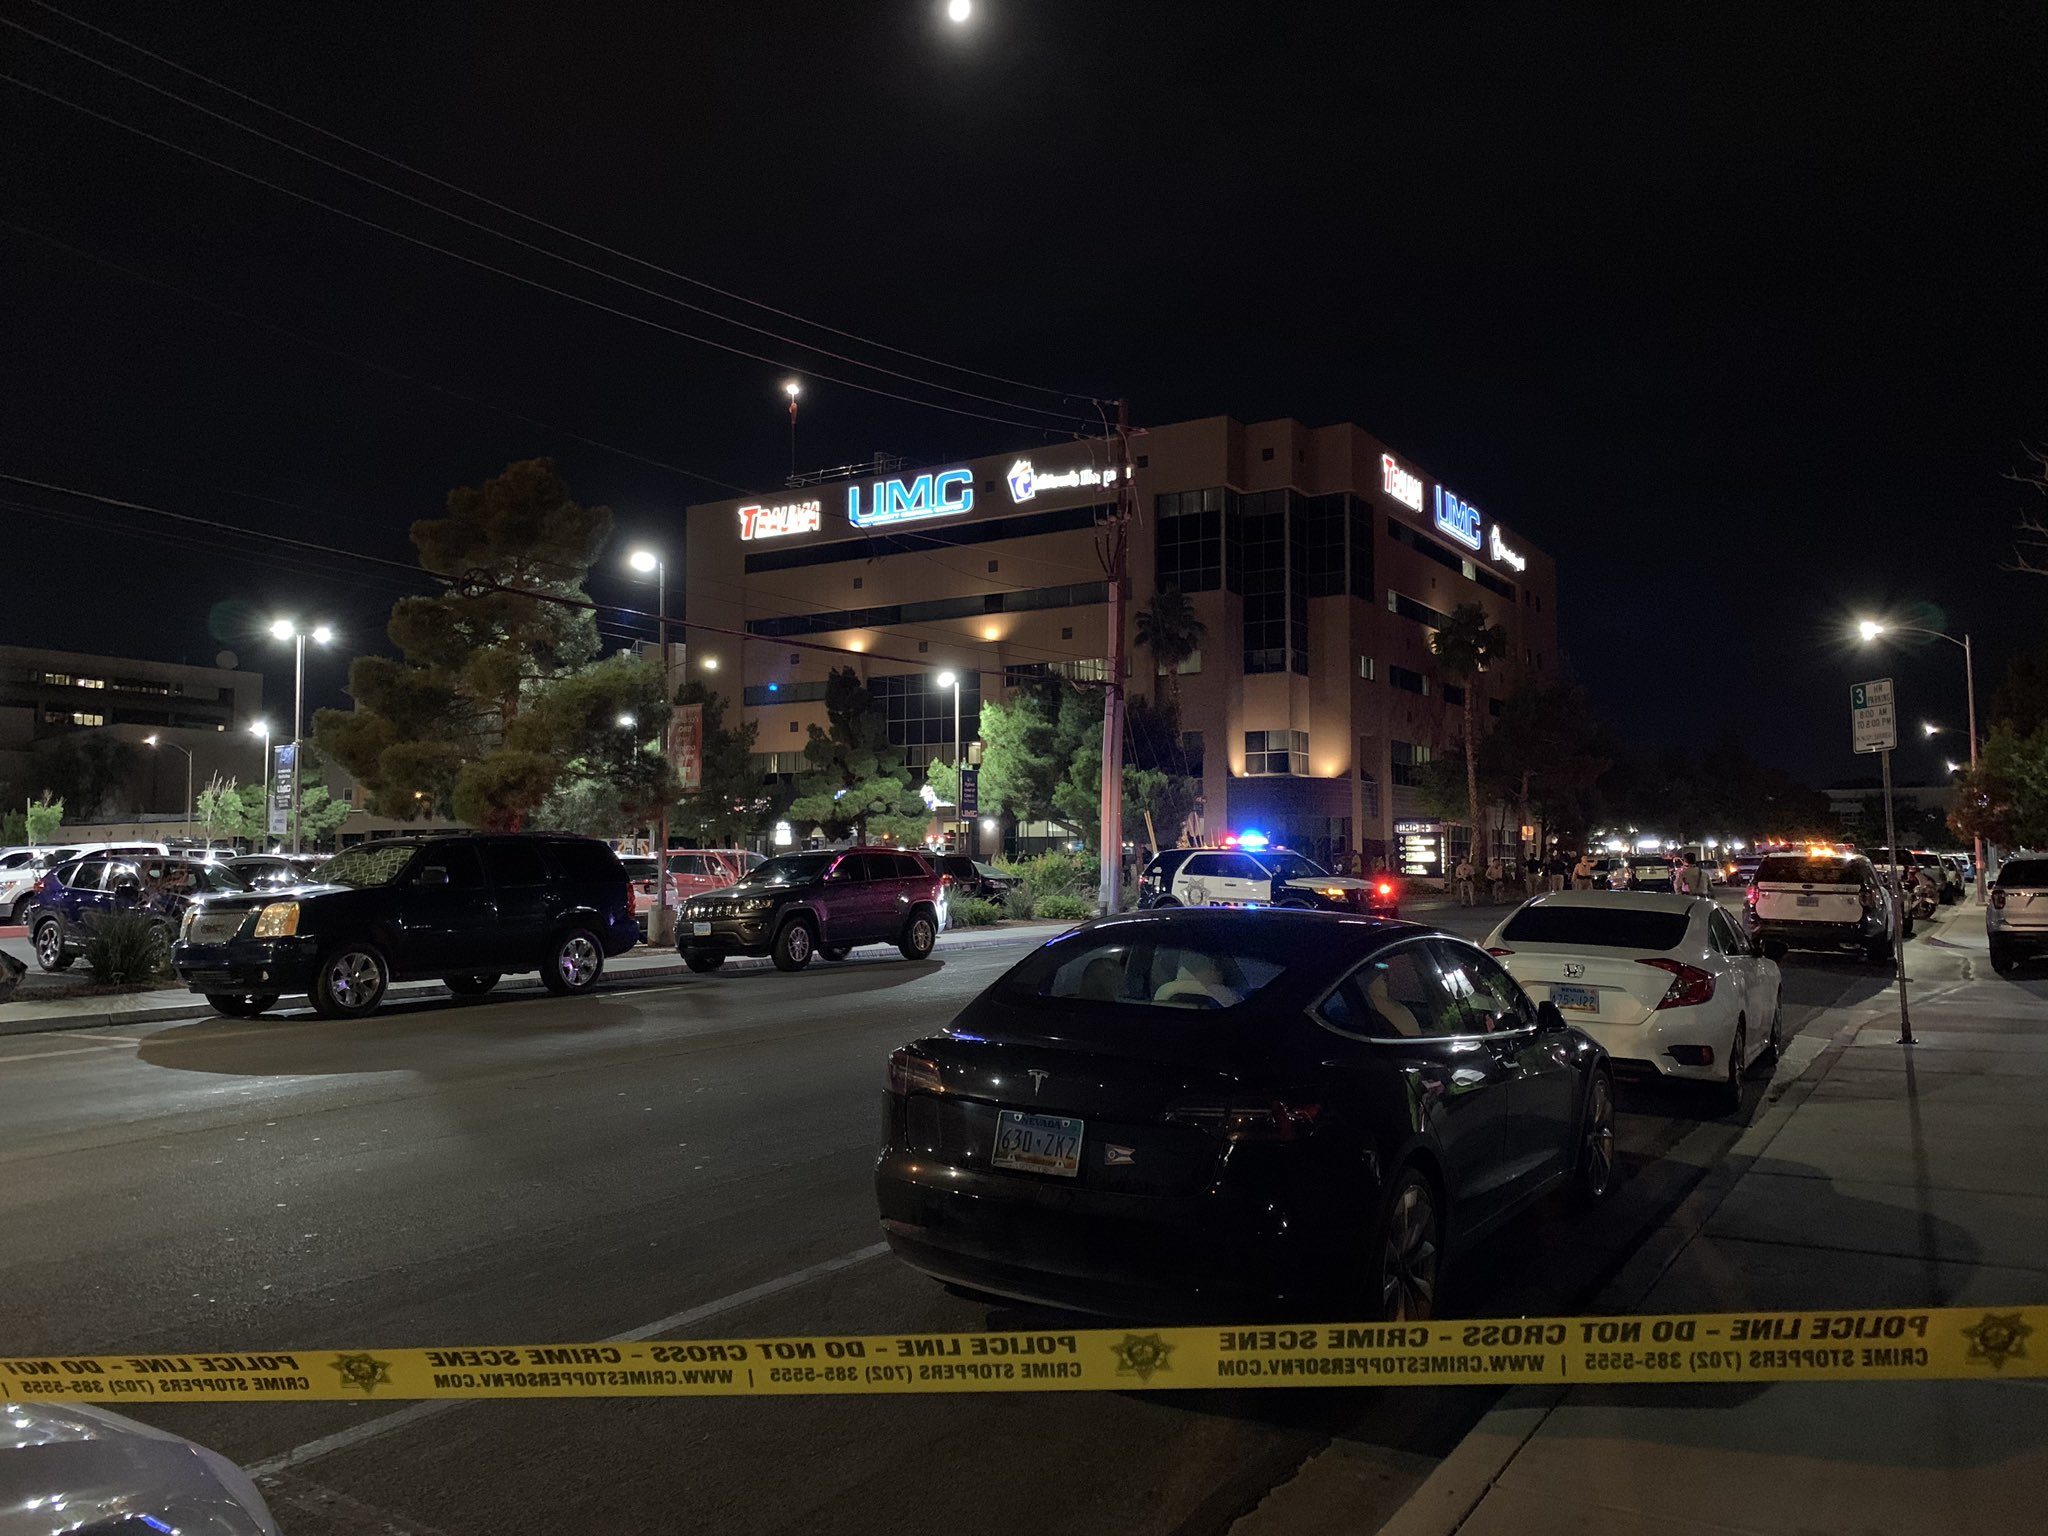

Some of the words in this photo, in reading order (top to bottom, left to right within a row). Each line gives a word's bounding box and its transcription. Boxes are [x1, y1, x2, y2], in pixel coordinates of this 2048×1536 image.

[849, 469, 974, 528] UMC
[1435, 484, 1481, 550] UMC
[1855, 688, 1864, 704] 3
[1878, 707, 1888, 716] AM
[1882, 717, 1892, 726] PM
